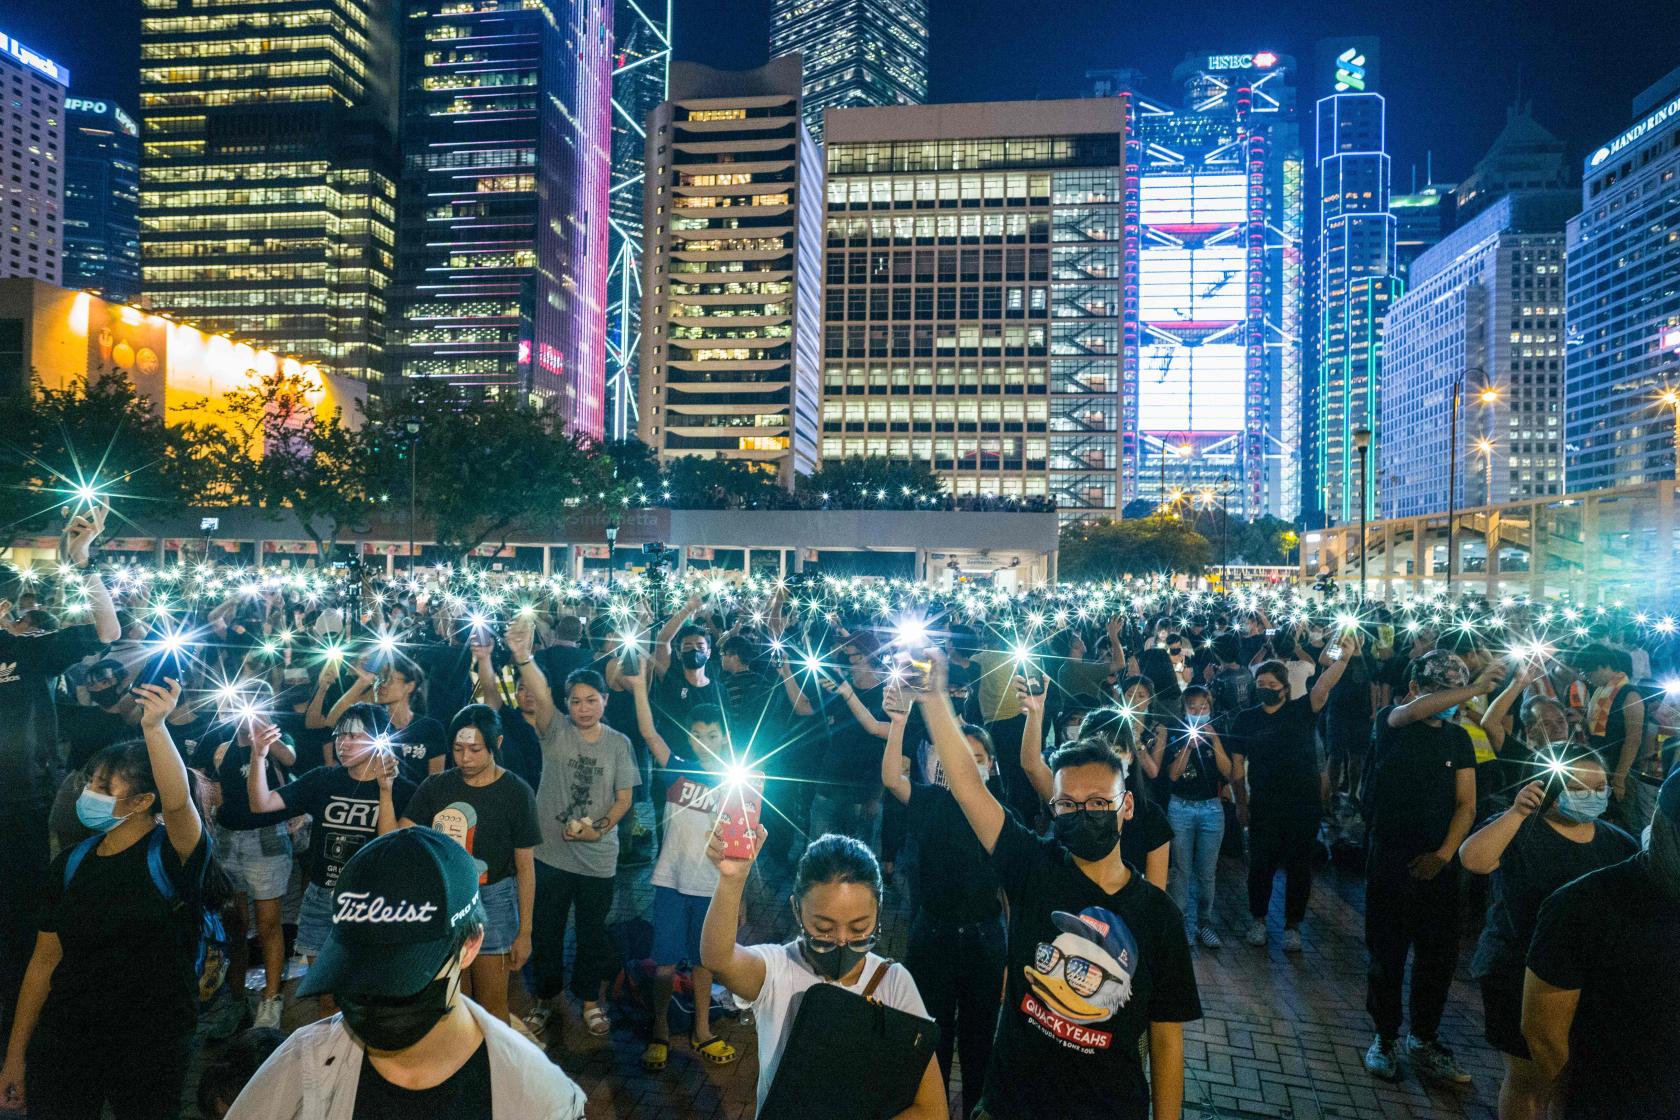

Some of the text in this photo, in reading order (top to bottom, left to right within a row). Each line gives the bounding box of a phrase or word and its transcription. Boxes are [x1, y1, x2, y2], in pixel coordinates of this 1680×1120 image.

[11, 38, 58, 79] Lynch
[1207, 54, 1253, 70] HSBC
[64, 98, 107, 114] IPPO
[567, 514, 658, 526] Sinfoetta
[324, 801, 380, 828] GR1
[332, 892, 438, 925] Titleist
[1026, 1000, 1108, 1048] QUACK YEAHS
